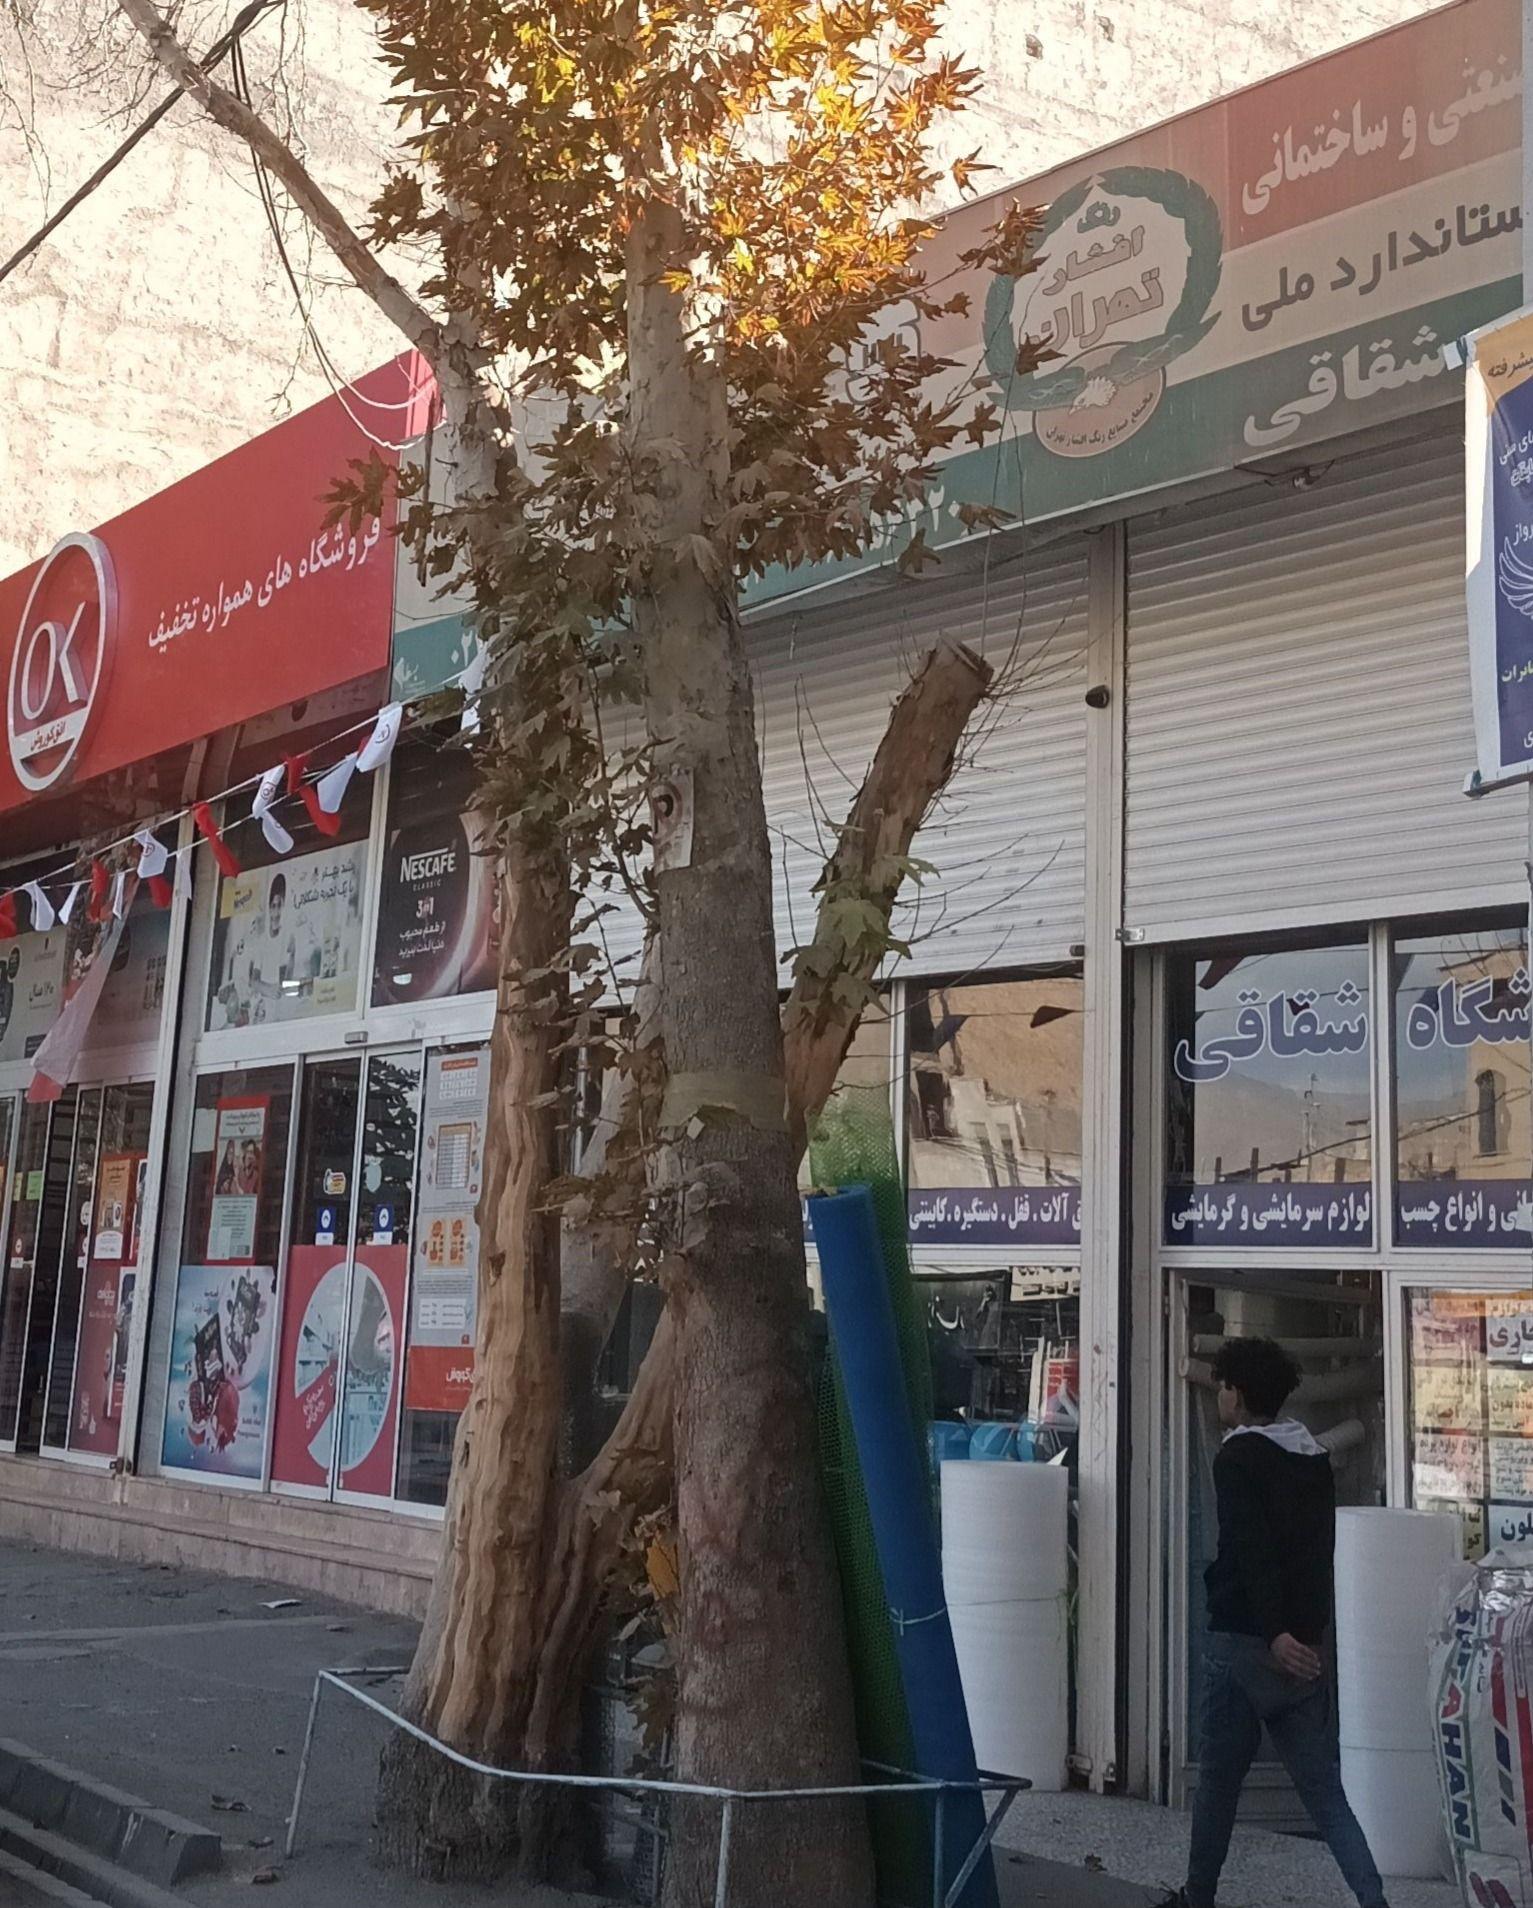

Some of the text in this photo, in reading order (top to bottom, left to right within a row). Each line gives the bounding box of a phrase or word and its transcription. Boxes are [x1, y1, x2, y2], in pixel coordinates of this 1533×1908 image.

[1241, 53, 1523, 216] نعتی و ساختمانی
[1028, 266, 1165, 353] تهران
[1042, 226, 1146, 297] افشار
[1241, 202, 1523, 333] ستاندارد ملی
[1243, 324, 1446, 448] شقاقی
[147, 514, 382, 654] فروشگاه های همواره تخفیف
[21, 600, 88, 721] OK
[1172, 966, 1533, 1083] شگاه شقاقی
[1171, 1190, 1371, 1232] لوازم سرمایشی و گرمایشی
[1400, 1199, 1441, 1233] چسب
[1444, 1189, 1484, 1232] انواع
[1486, 1203, 1497, 1232] و
